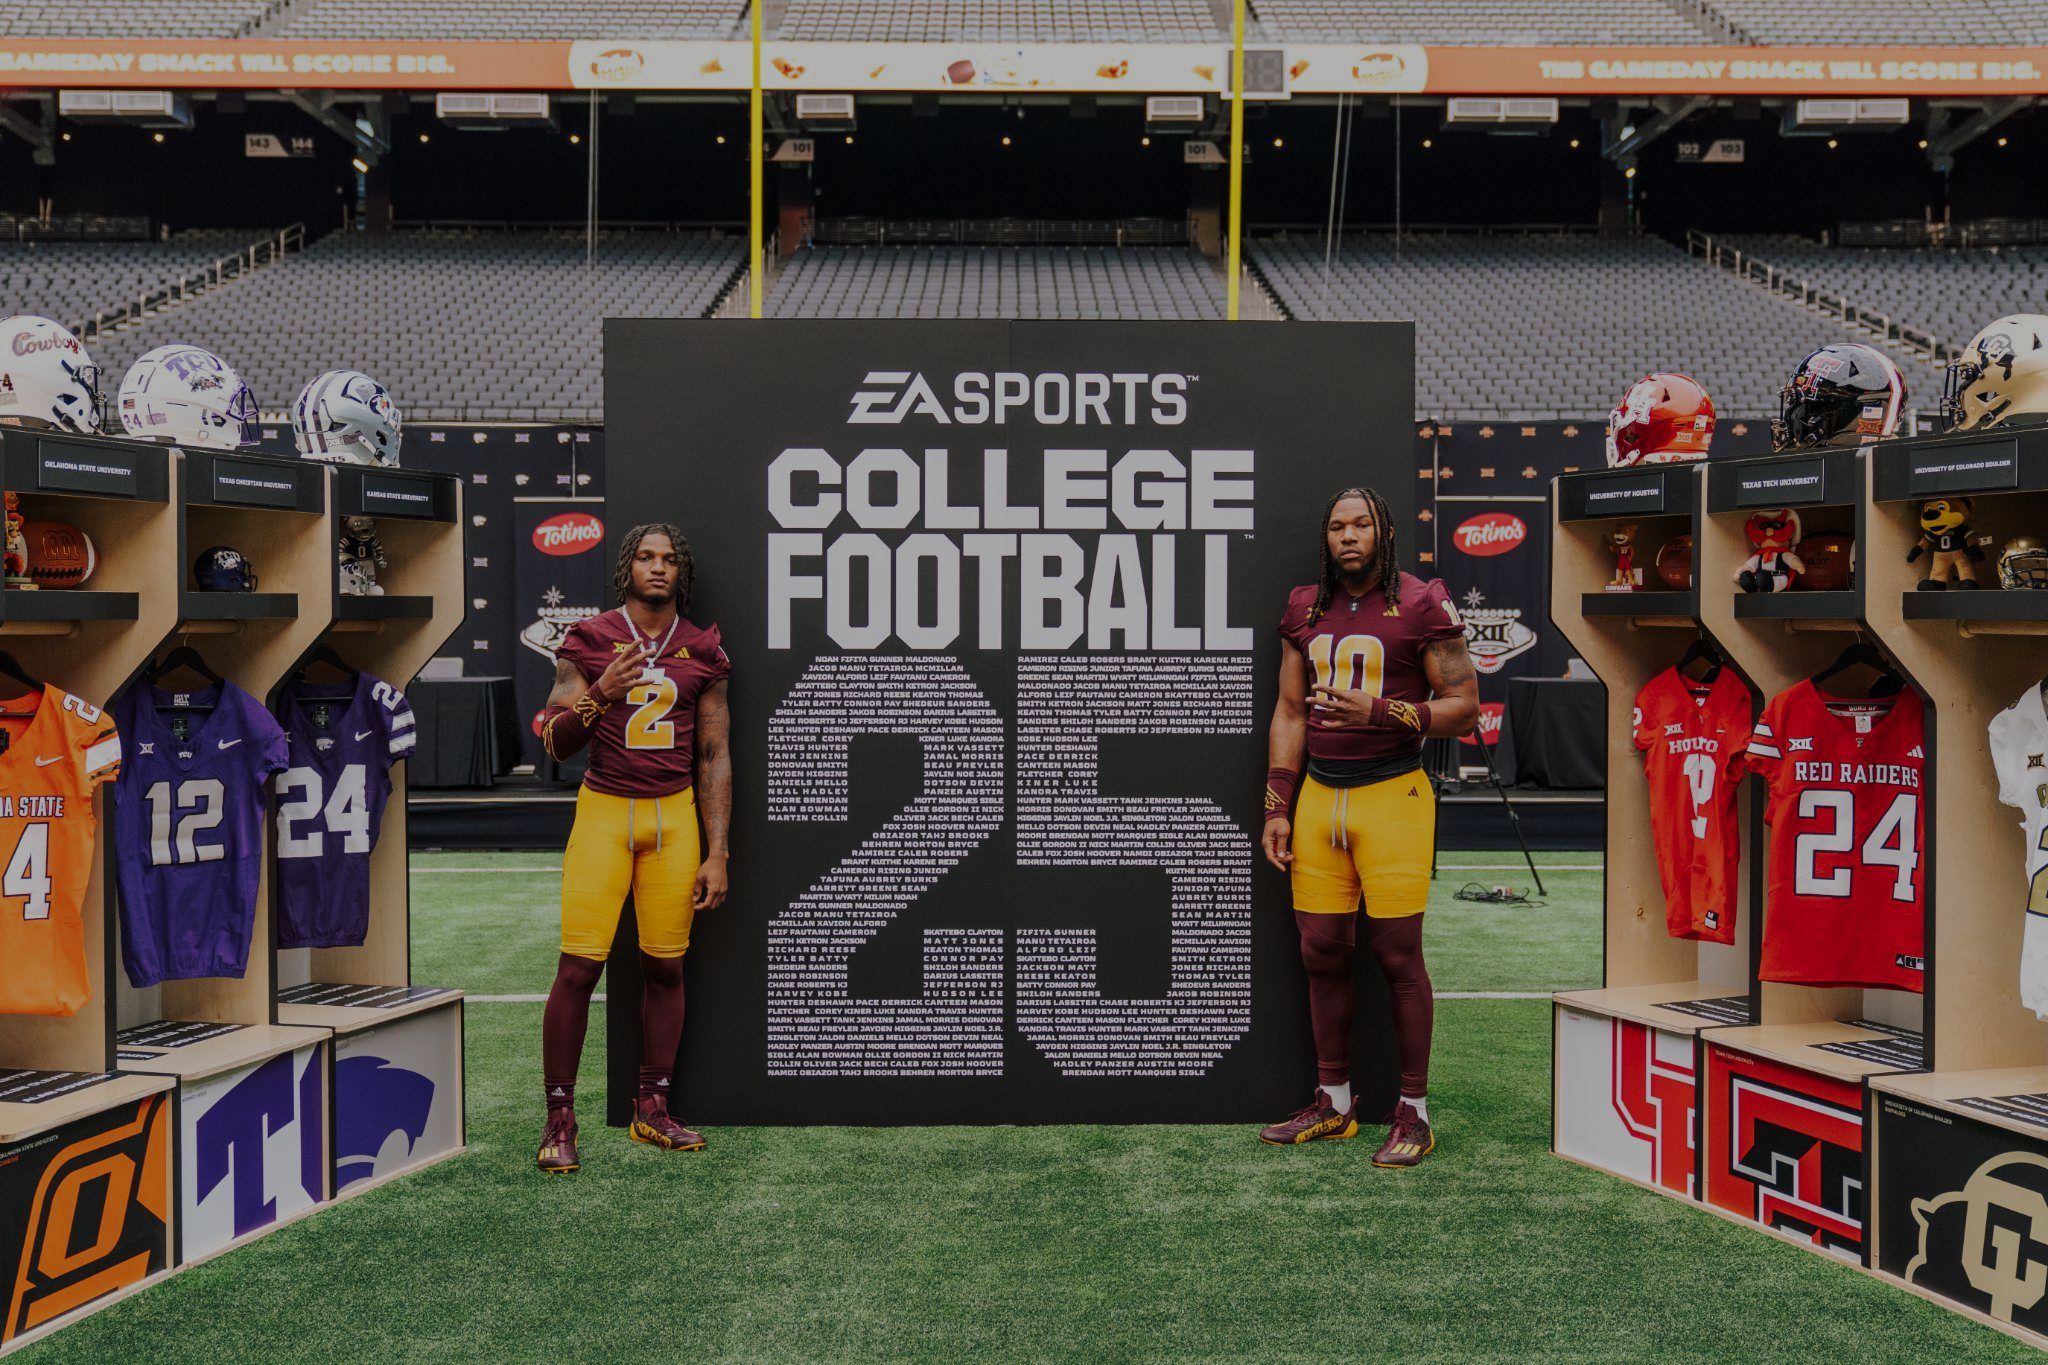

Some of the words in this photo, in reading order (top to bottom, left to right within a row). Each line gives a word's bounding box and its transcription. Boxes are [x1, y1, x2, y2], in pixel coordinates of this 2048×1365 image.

[139, 53, 236, 72] SNACK
[241, 53, 289, 72] WILL
[292, 53, 392, 73] SCORE
[396, 54, 456, 73] BIG.
[1539, 61, 1585, 79] THIS
[1589, 61, 1726, 79] GAMEDAY
[1729, 60, 1825, 79] SNACK
[1829, 61, 1877, 79] WILL
[1880, 61, 1978, 80] SCORE
[1982, 61, 2042, 80] BIG.
[249, 138, 270, 148] 143
[793, 143, 812, 153] 101
[1188, 144, 1207, 154] 101
[846, 372, 952, 424] EA
[44, 461, 77, 470] OKLAHOMA
[78, 464, 96, 472] STATE
[97, 466, 132, 476] UNIVERSITY
[1914, 465, 1948, 474] UNIVERSITY
[1956, 462, 1984, 470] COLORADO
[236, 478, 262, 487] CHRISTIAN
[264, 480, 292, 490] UNIVERSITY
[768, 448, 1254, 530] COLLEGE
[1742, 481, 1762, 489] TEXAS
[1779, 476, 1818, 486] UNIVERSITY
[401, 493, 429, 502] UNIVERSITY
[1590, 491, 1623, 500] UNIVERSITY
[1632, 488, 1659, 498] HOUSTON
[536, 518, 602, 548] Totino's
[1457, 518, 1524, 548] Totino's
[1472, 624, 1505, 641] XII
[1308, 634, 1385, 712] 10
[370, 680, 404, 712] 2
[62, 694, 102, 724] 2
[624, 676, 678, 750] 2
[1664, 722, 1684, 736] XII
[1788, 737, 1814, 752] XII
[178, 751, 193, 759] TCU
[2027, 754, 2045, 769] XII
[1795, 762, 1833, 782] RED
[1840, 763, 1918, 788] RAIDERS
[18, 796, 64, 818] STATE
[276, 764, 371, 858] 24
[144, 778, 226, 866] 12
[1794, 788, 1920, 902] 24
[2, 822, 52, 920] 4
